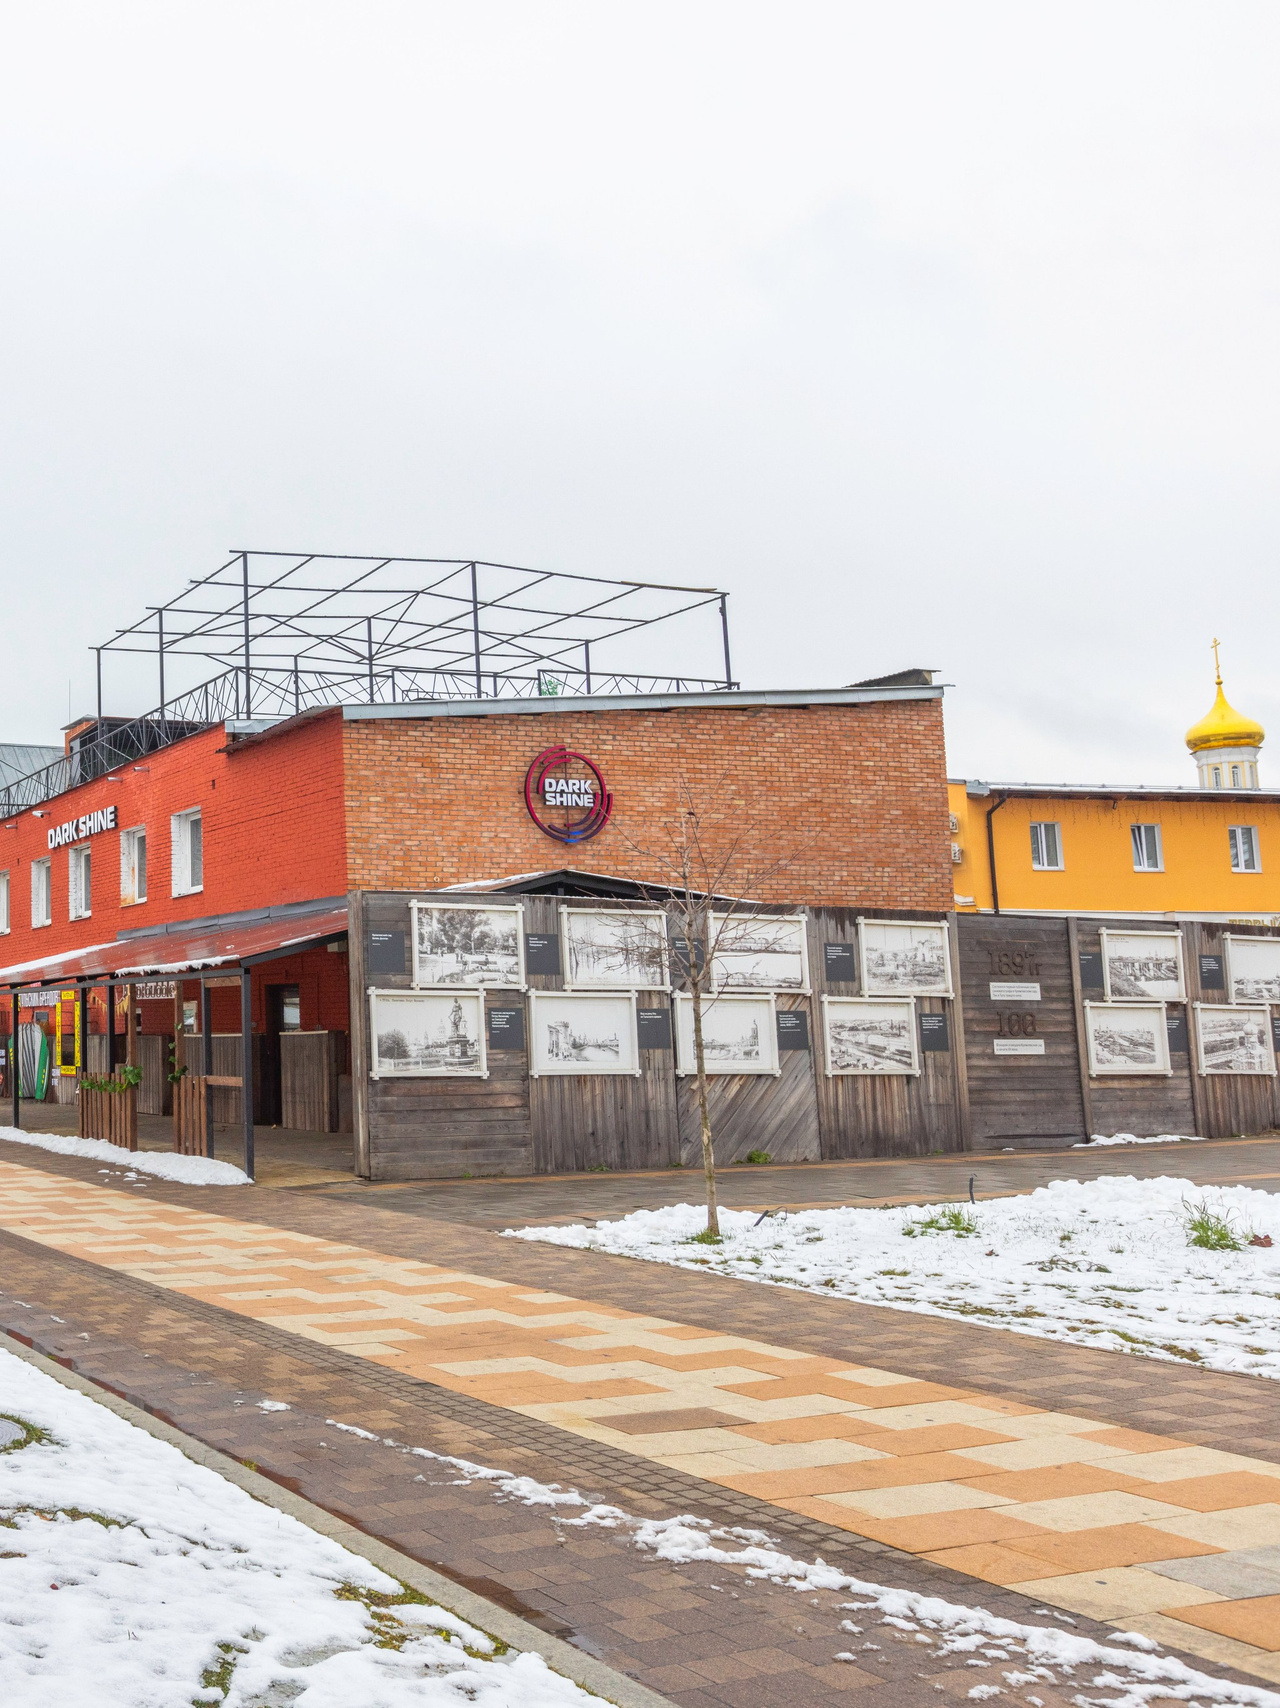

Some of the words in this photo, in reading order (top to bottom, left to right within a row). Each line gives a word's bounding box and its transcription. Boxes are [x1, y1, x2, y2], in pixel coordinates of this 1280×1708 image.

[544, 778, 593, 794] DARK
[545, 793, 594, 807] SHINE
[48, 819, 78, 849] DARK
[78, 806, 116, 839] SHINE
